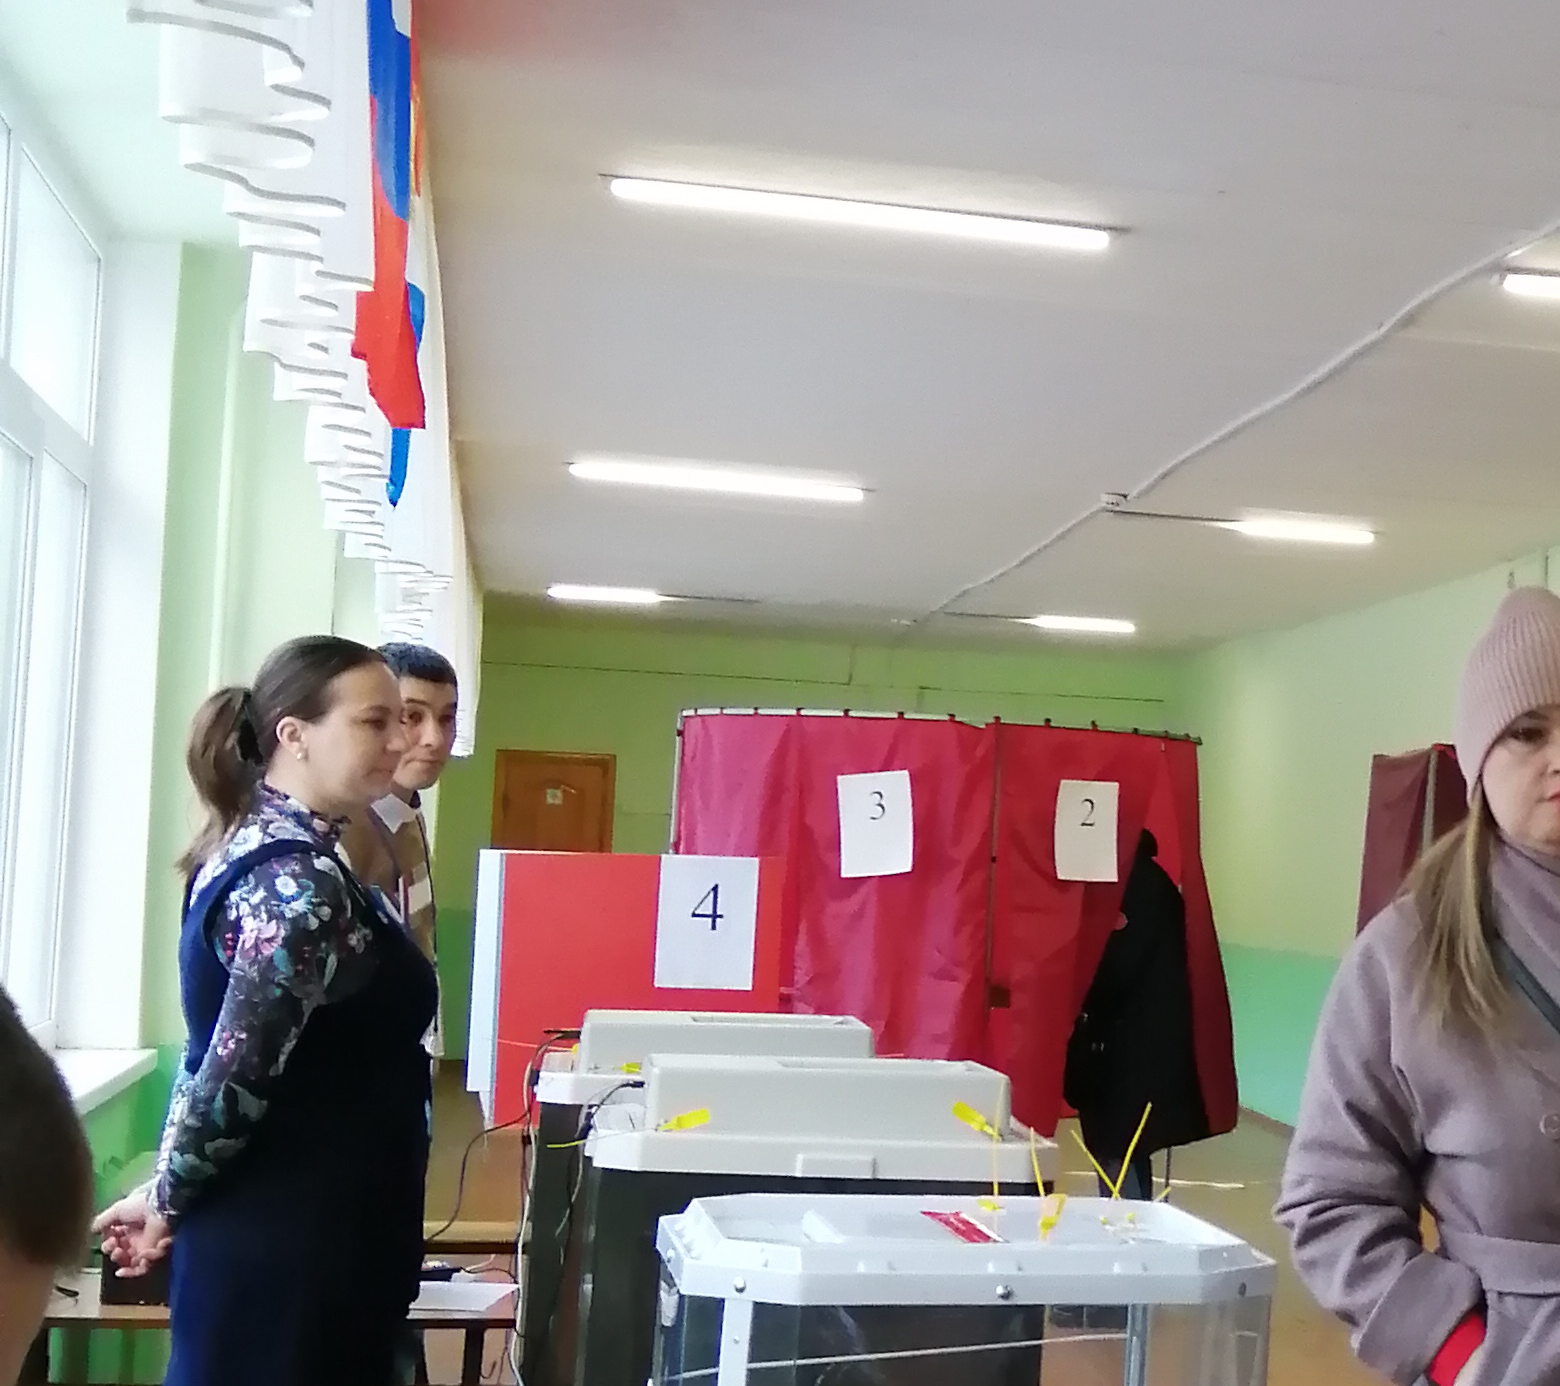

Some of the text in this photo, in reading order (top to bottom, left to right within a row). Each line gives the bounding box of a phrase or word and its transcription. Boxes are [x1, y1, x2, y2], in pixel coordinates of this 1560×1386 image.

[869, 791, 885, 821] 3
[1080, 798, 1096, 827] 2
[691, 883, 724, 931] 4
